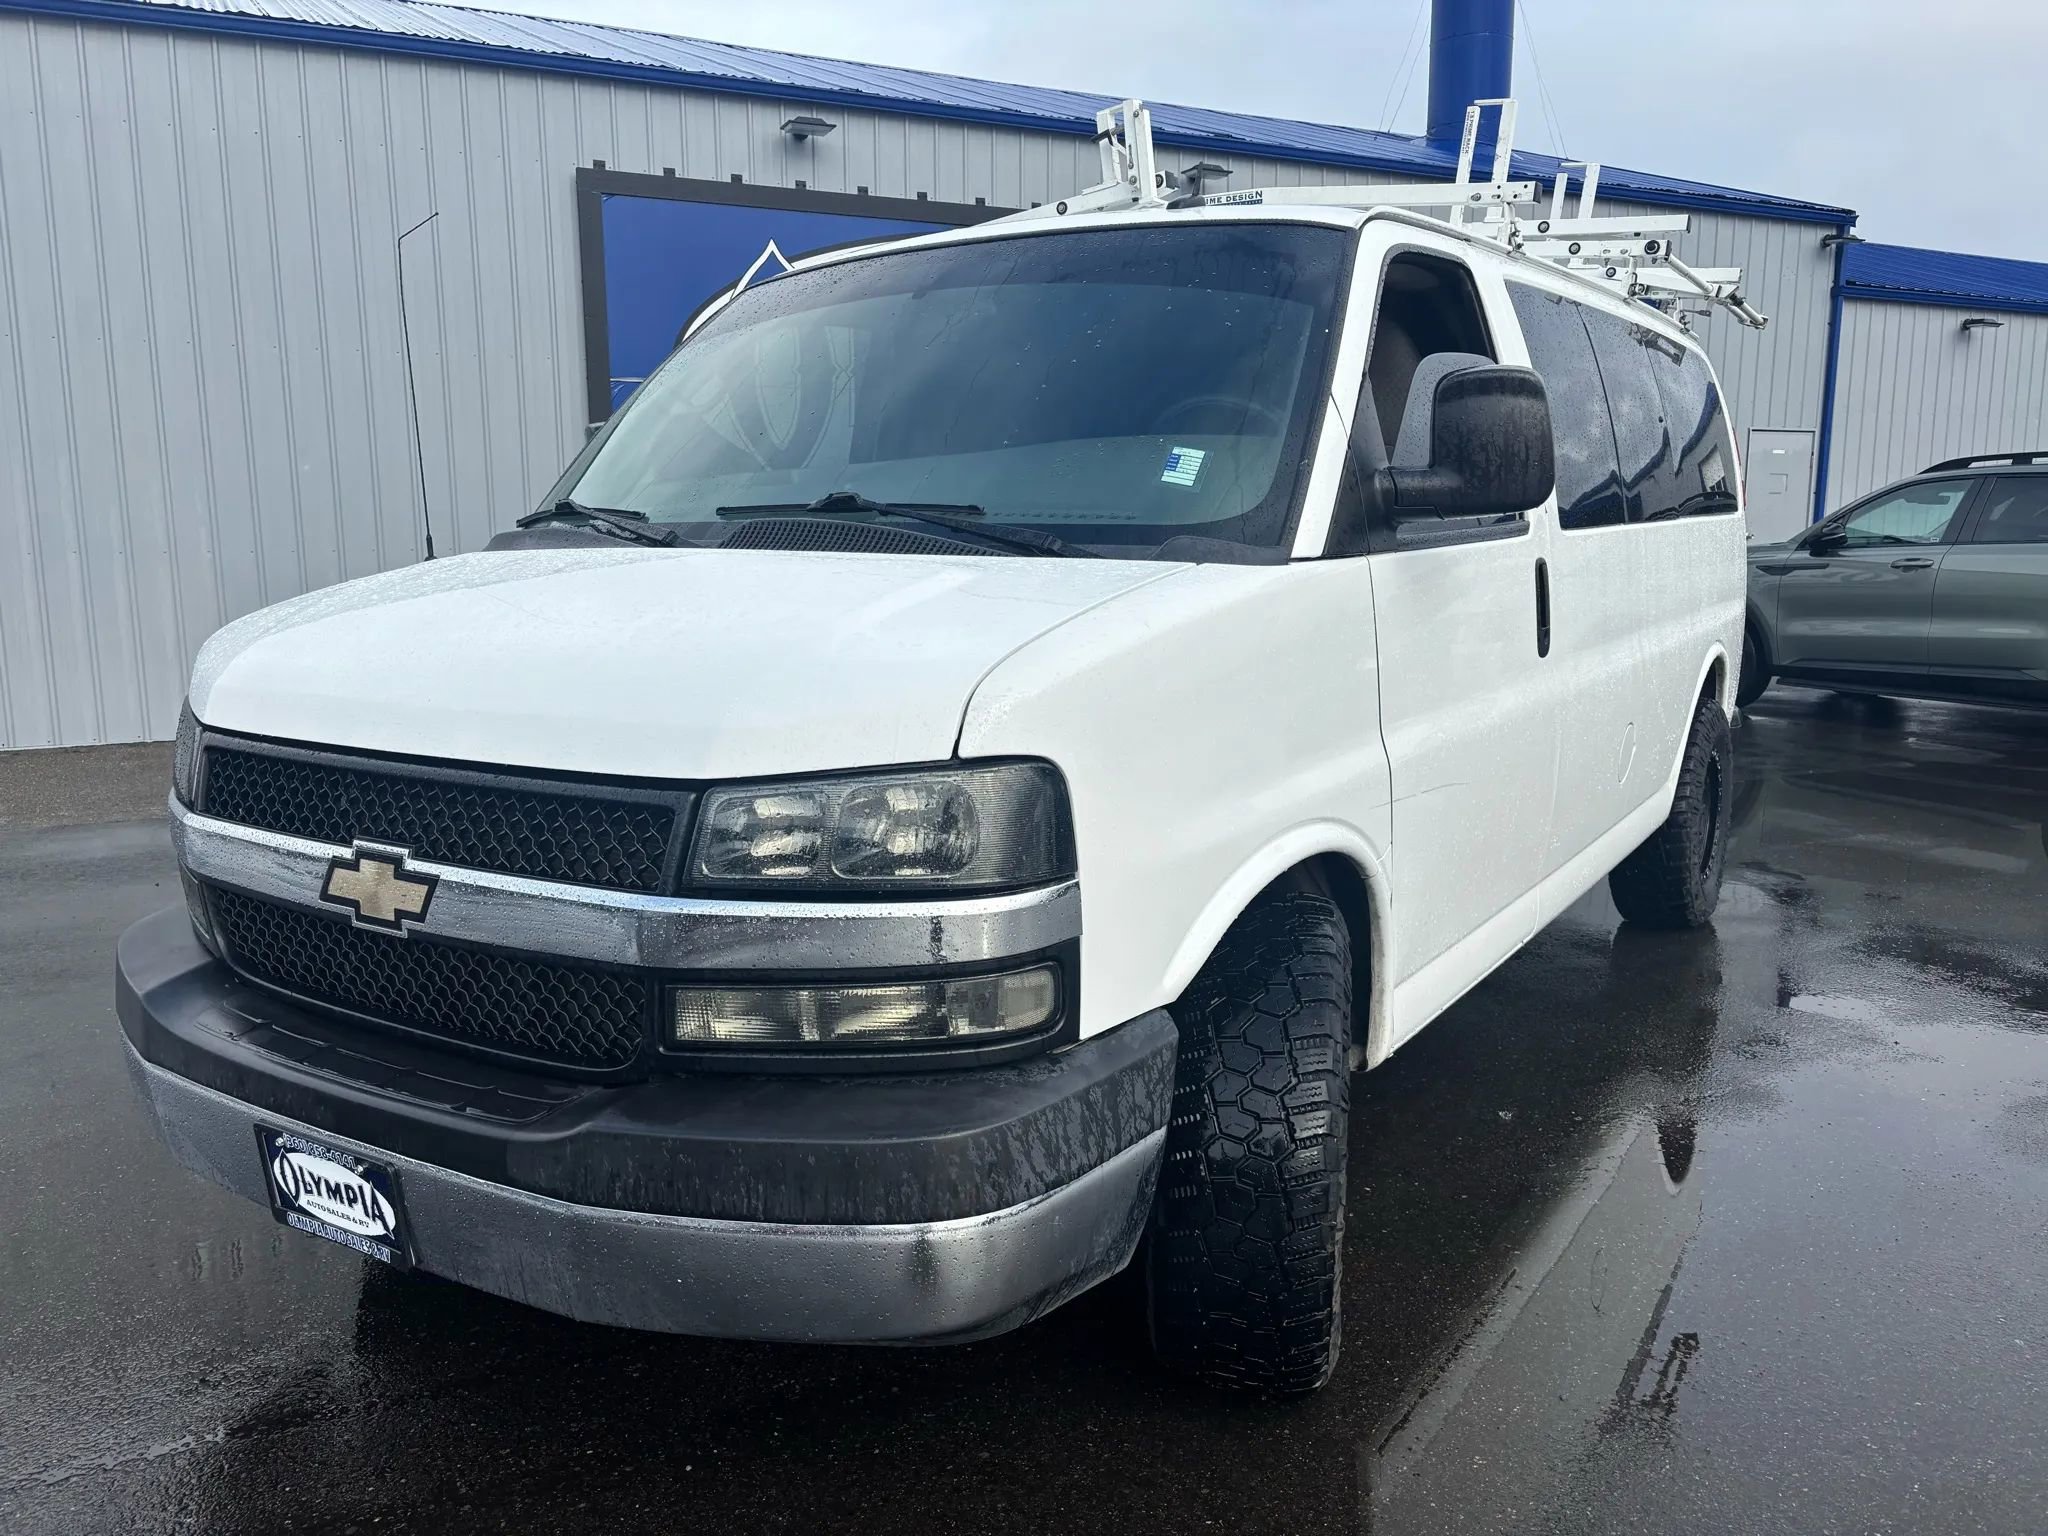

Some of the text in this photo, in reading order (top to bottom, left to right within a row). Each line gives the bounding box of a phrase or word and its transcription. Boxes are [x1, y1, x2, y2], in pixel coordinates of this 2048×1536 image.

[1226, 190, 1263, 202] DESIGN
[278, 1147, 396, 1240] OLYMPIA
[306, 1199, 326, 1212] AUTO
[326, 1206, 352, 1222] SALES
[358, 1219, 370, 1228] RV
[286, 1211, 325, 1237] OLYMPIA
[324, 1224, 347, 1245] AUTO
[346, 1233, 372, 1255] SALES
